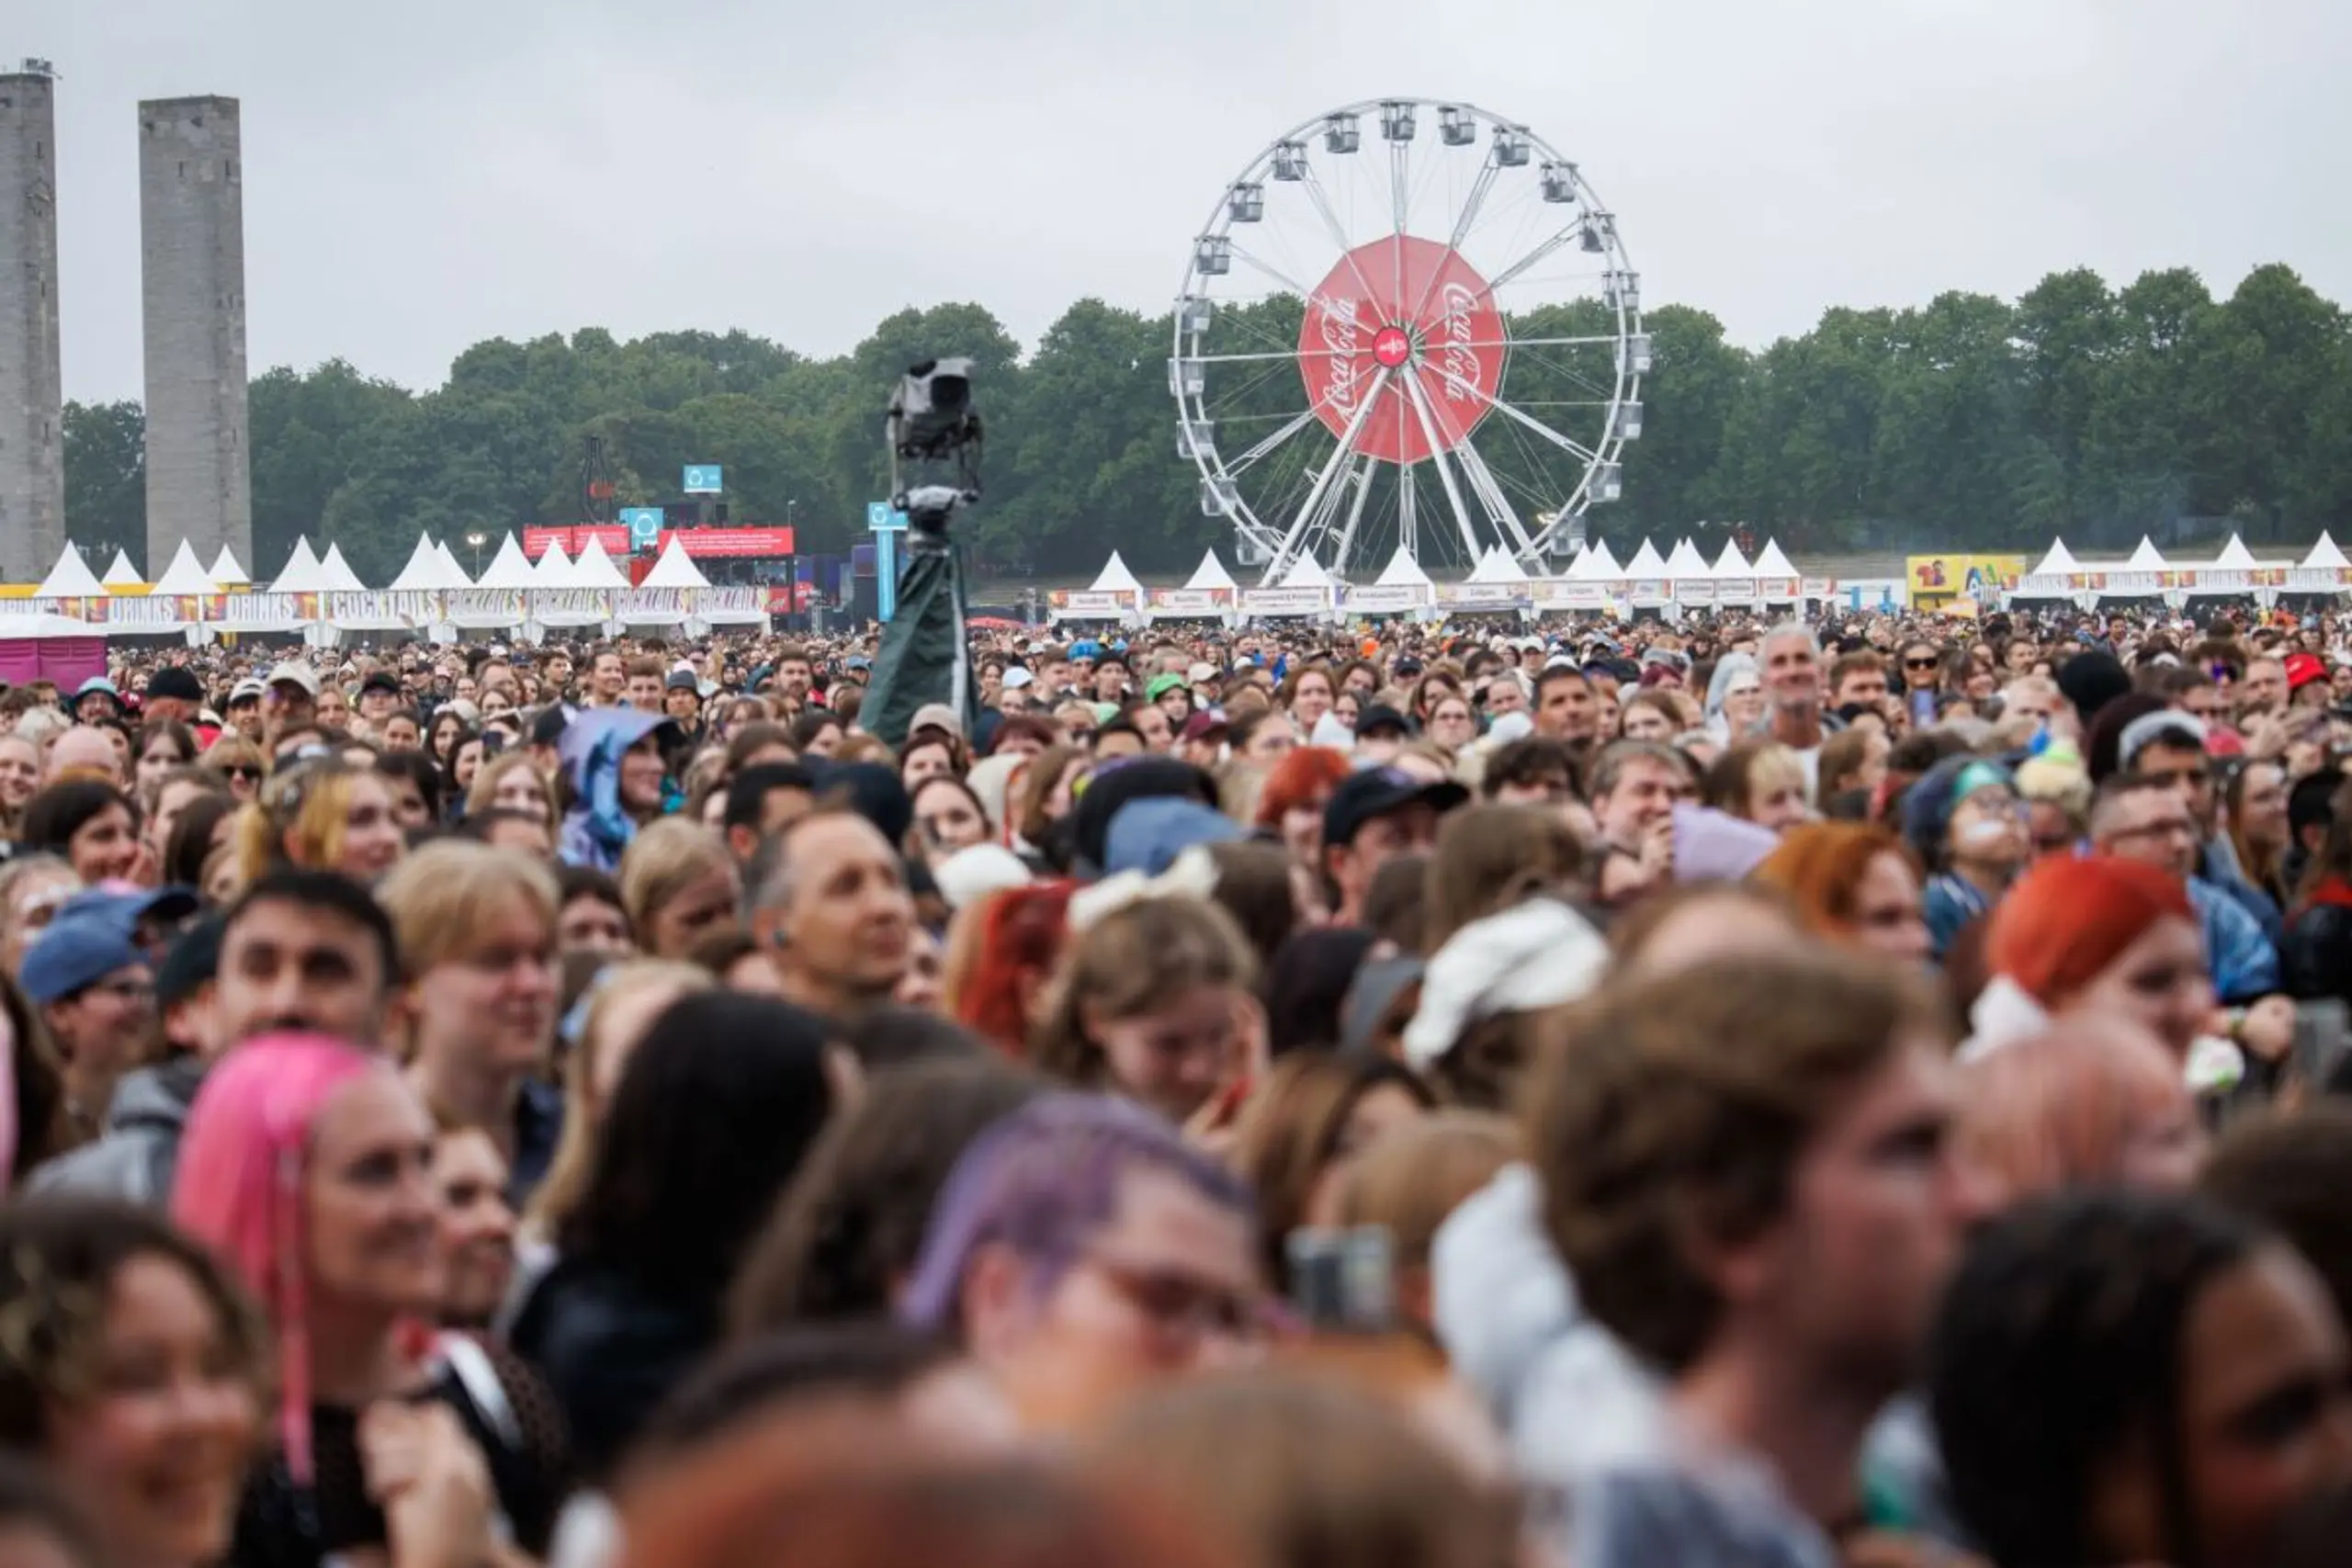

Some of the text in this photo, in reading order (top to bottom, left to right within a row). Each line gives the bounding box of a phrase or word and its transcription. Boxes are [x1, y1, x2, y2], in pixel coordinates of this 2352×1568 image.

[113, 595, 175, 624] DRINKS
[230, 593, 292, 621] DRINKS
[334, 590, 437, 619] COCKTAILS
[534, 589, 606, 615] COCKTAILS
[613, 587, 685, 614] COCKTAILS
[697, 586, 769, 614] COCKTAILS
